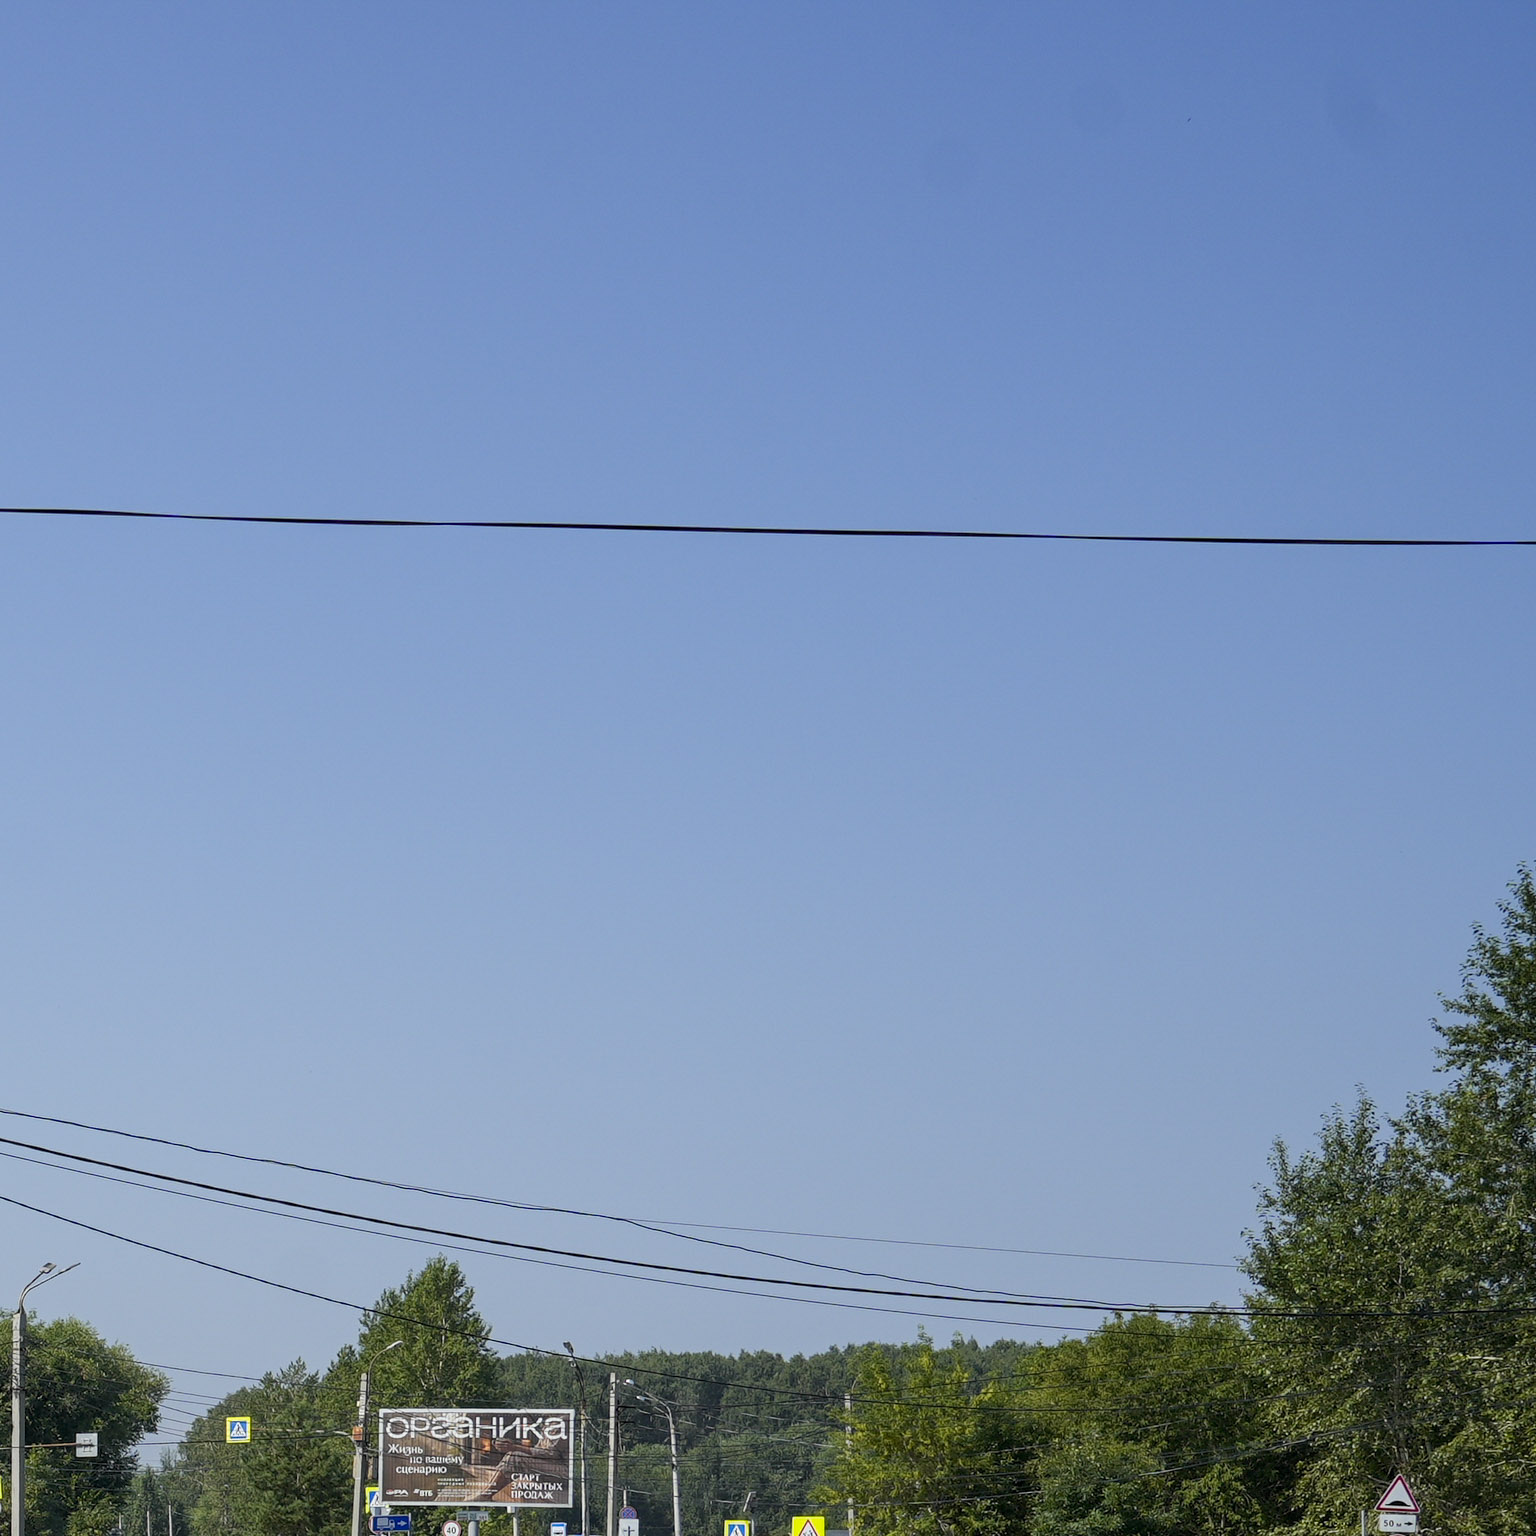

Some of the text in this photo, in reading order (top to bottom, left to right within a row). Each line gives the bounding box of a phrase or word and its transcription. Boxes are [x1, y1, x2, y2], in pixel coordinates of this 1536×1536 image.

[387, 1443, 424, 1456] Жизнь
[409, 1456, 464, 1466] по вашему
[395, 1466, 448, 1475] сценарию
[510, 1473, 541, 1482] СТАРТ
[510, 1482, 563, 1491] ЗАКРЫТЫХ
[510, 1491, 554, 1500] ПРОДАЖ
[1383, 1519, 1395, 1528] 50
[446, 1526, 457, 1534] 40
